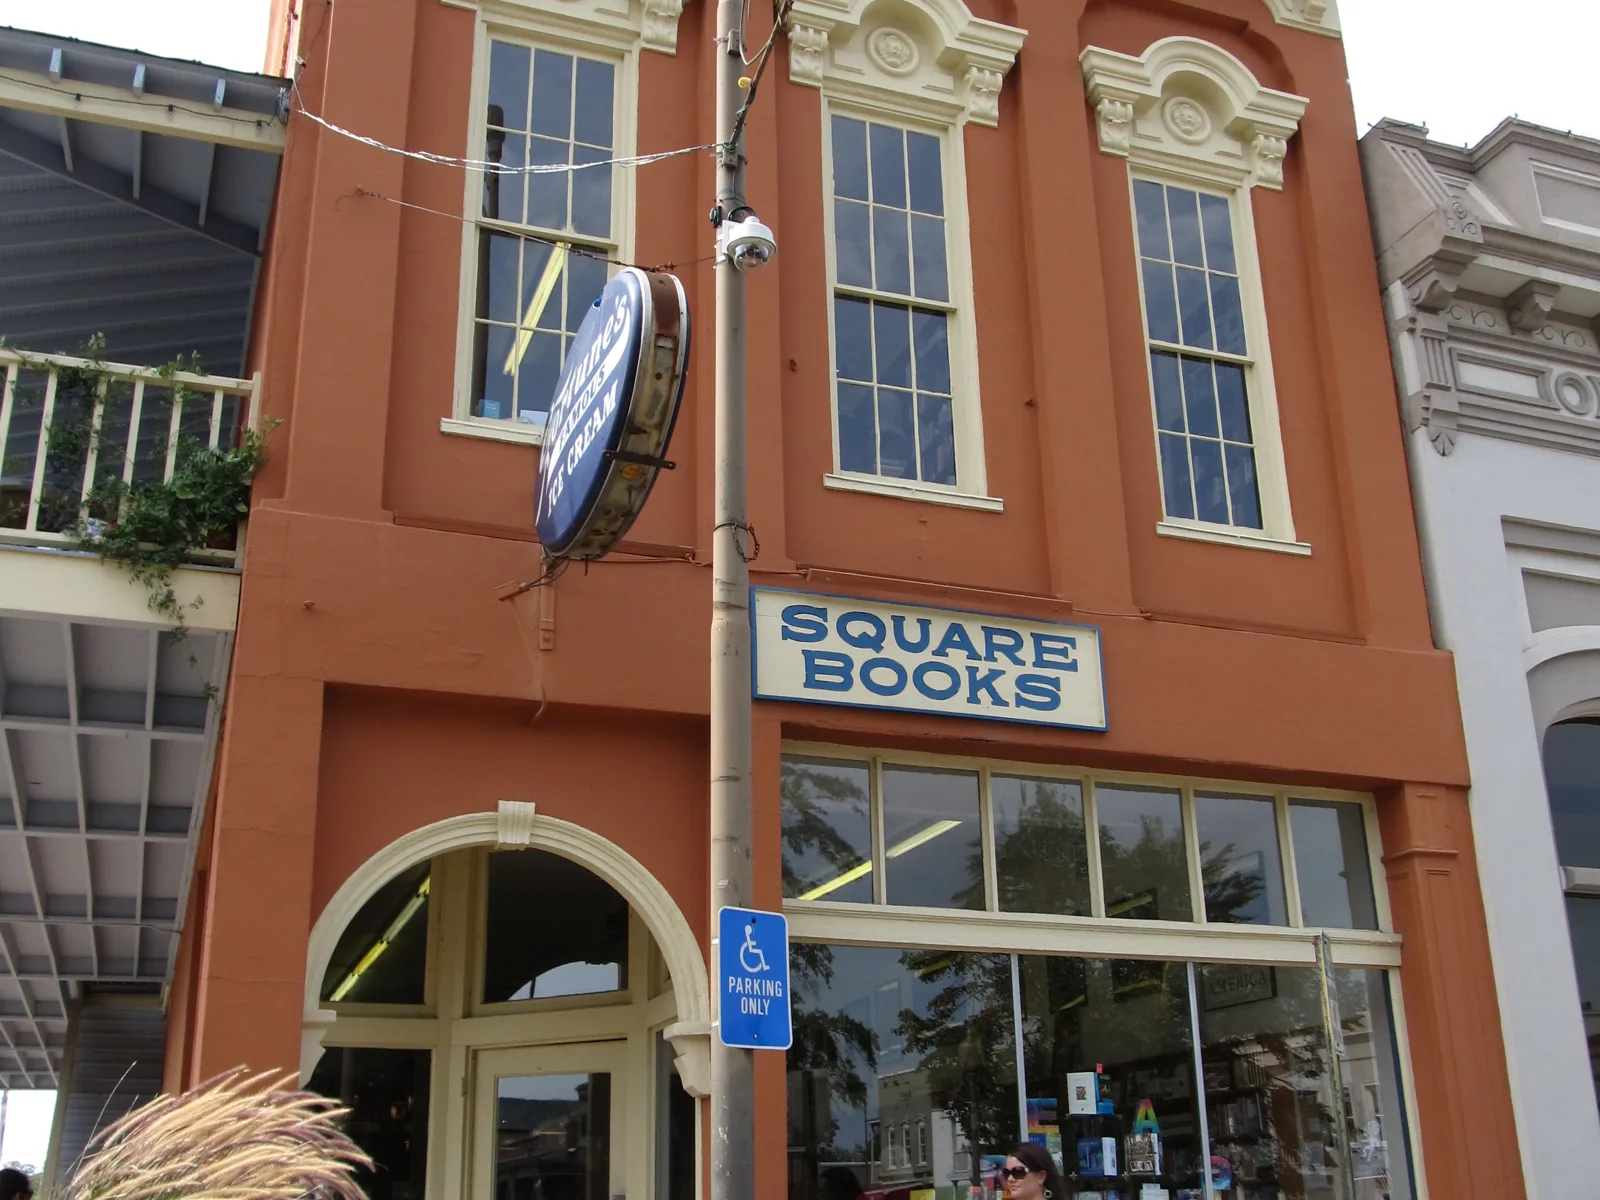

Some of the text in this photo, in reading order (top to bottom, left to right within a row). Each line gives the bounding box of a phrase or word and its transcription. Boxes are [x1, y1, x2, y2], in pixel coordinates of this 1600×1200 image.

[558, 364, 607, 452] FAMOUS
[547, 378, 618, 519] ICE CREAM
[781, 604, 1079, 673] SQUARE
[801, 648, 1062, 712] BOOKS
[728, 976, 783, 998] PARKING
[740, 996, 771, 1016] ONLY
